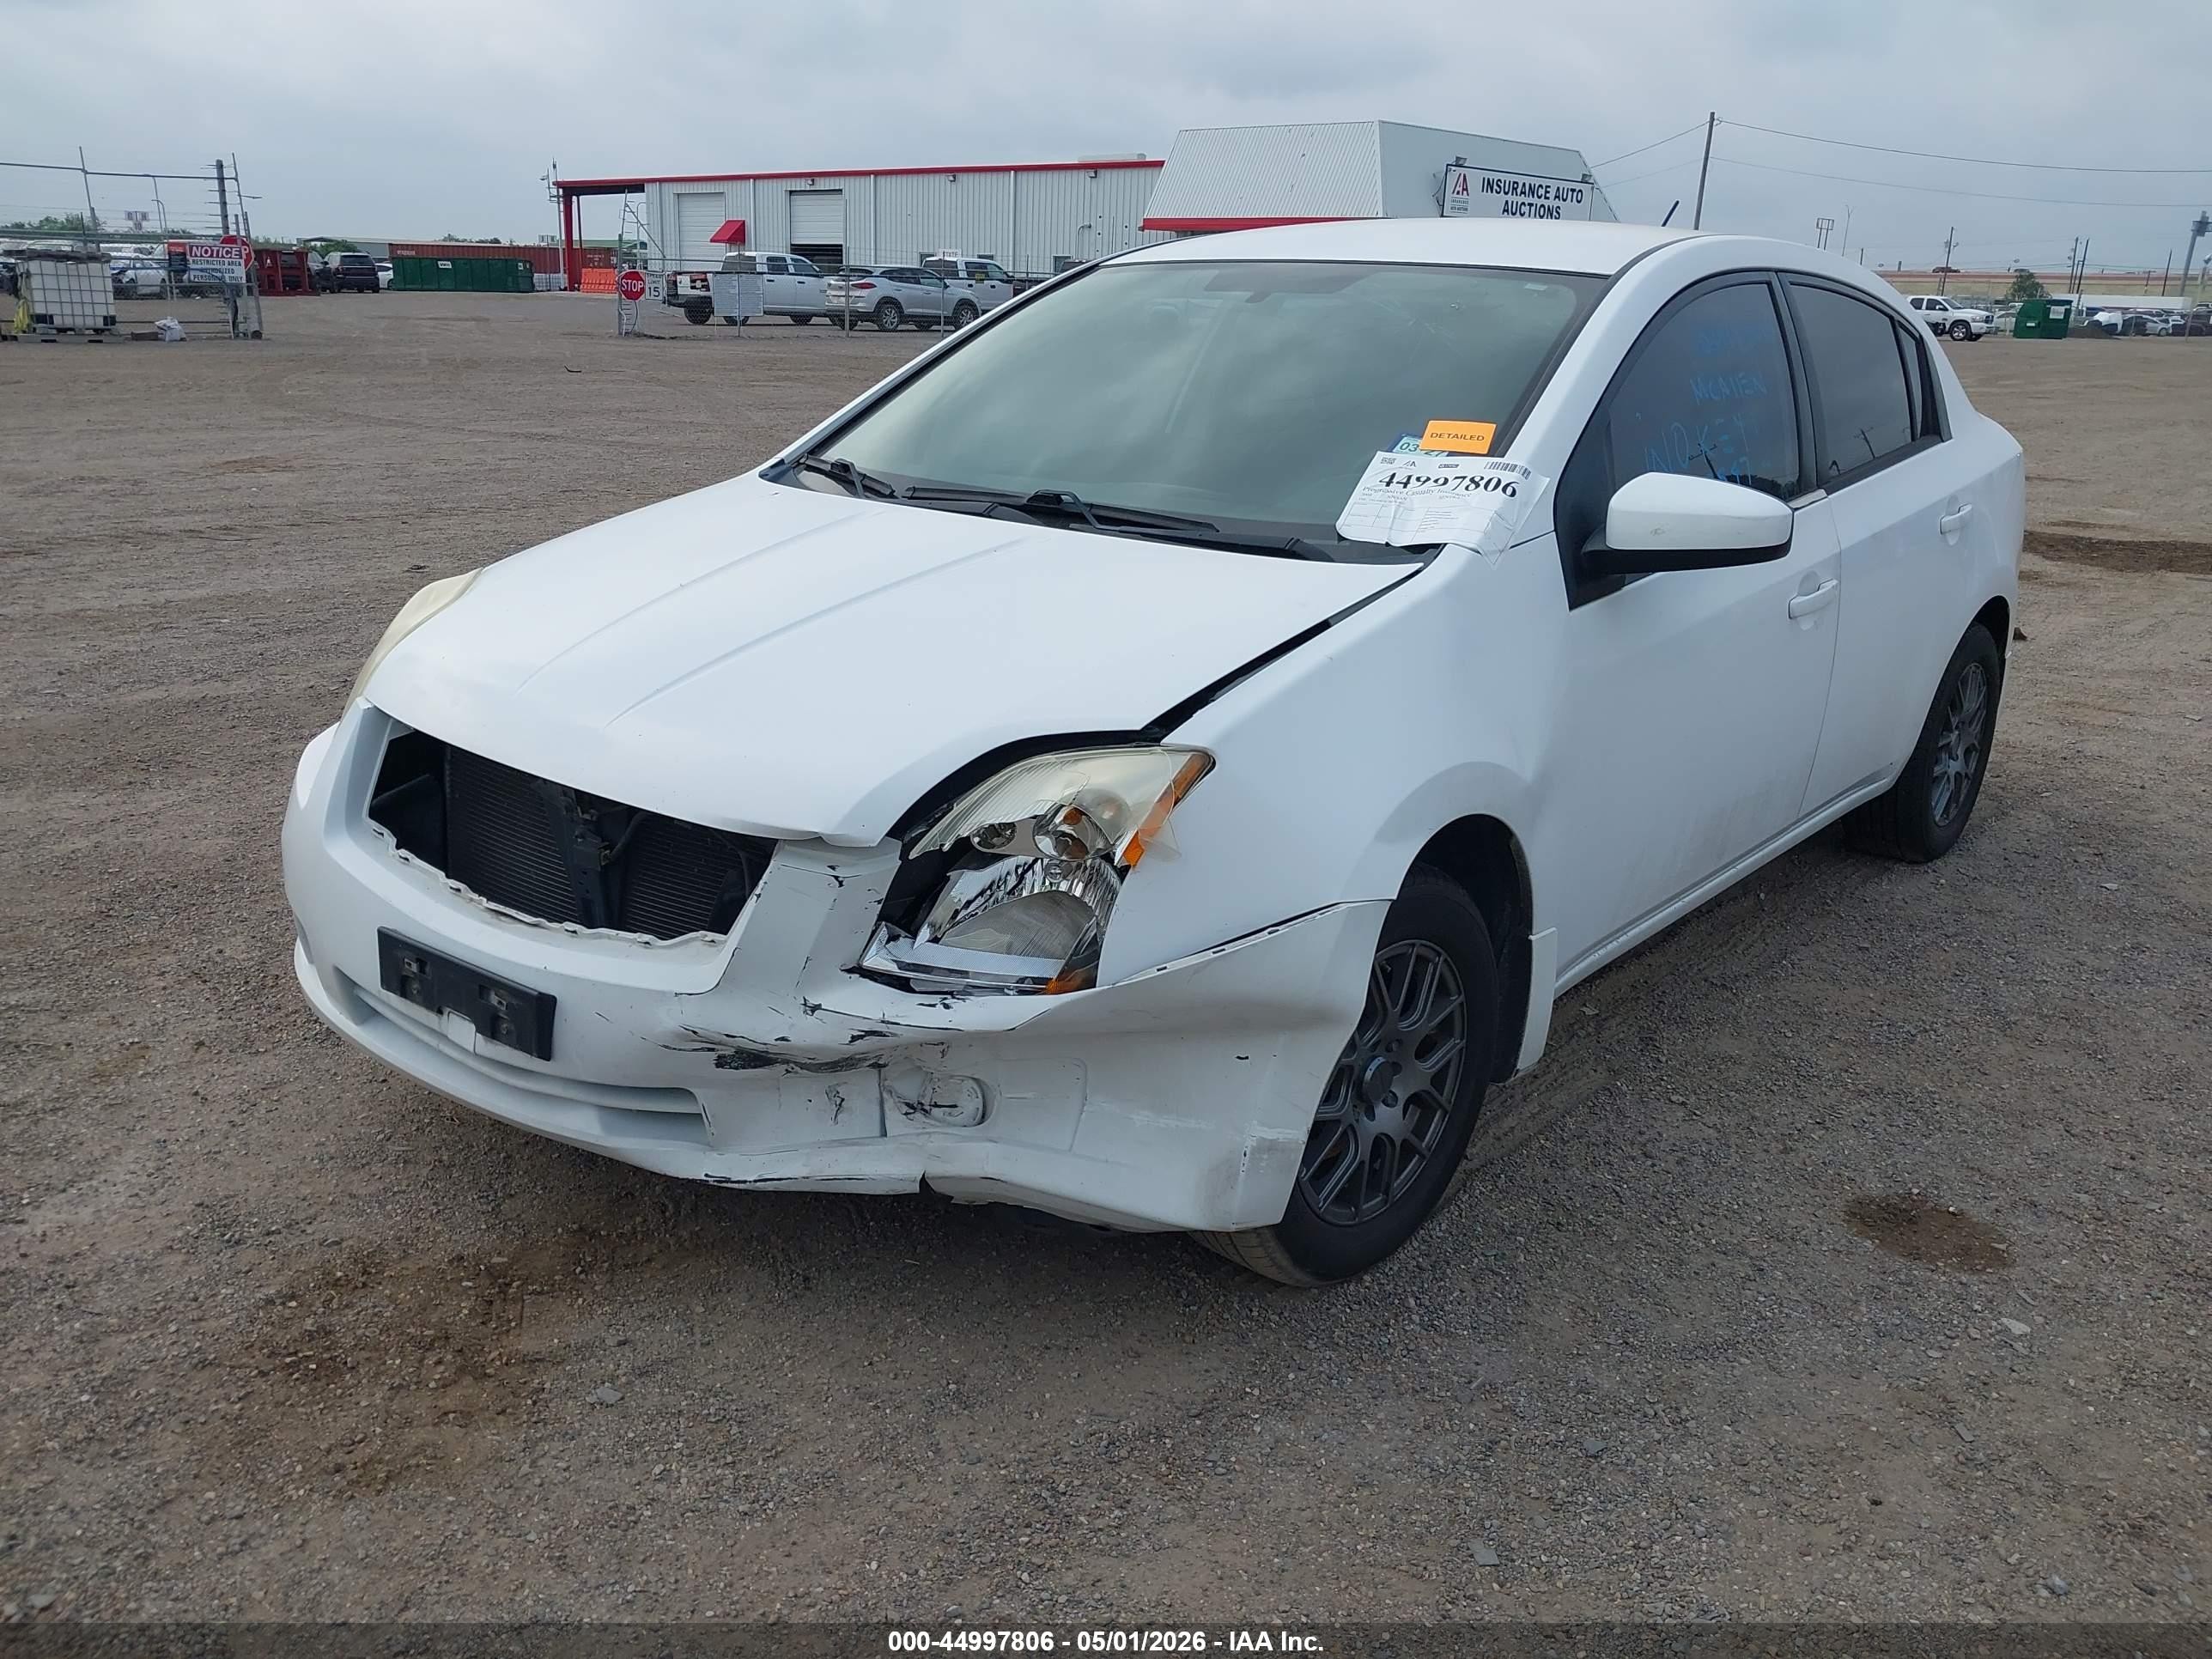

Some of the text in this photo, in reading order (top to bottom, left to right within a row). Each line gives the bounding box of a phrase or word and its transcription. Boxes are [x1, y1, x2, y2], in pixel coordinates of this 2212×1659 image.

[1481, 177, 1583, 204] INSURANCE AUTO
[1502, 199, 1561, 220] AUCTIONS
[191, 246, 240, 258] NOTICE
[622, 279, 644, 292] STOP
[648, 286, 660, 298] 15
[1430, 432, 1485, 441] DETAILED
[1400, 442, 1419, 453] 03
[1379, 471, 1520, 498] 44997806
